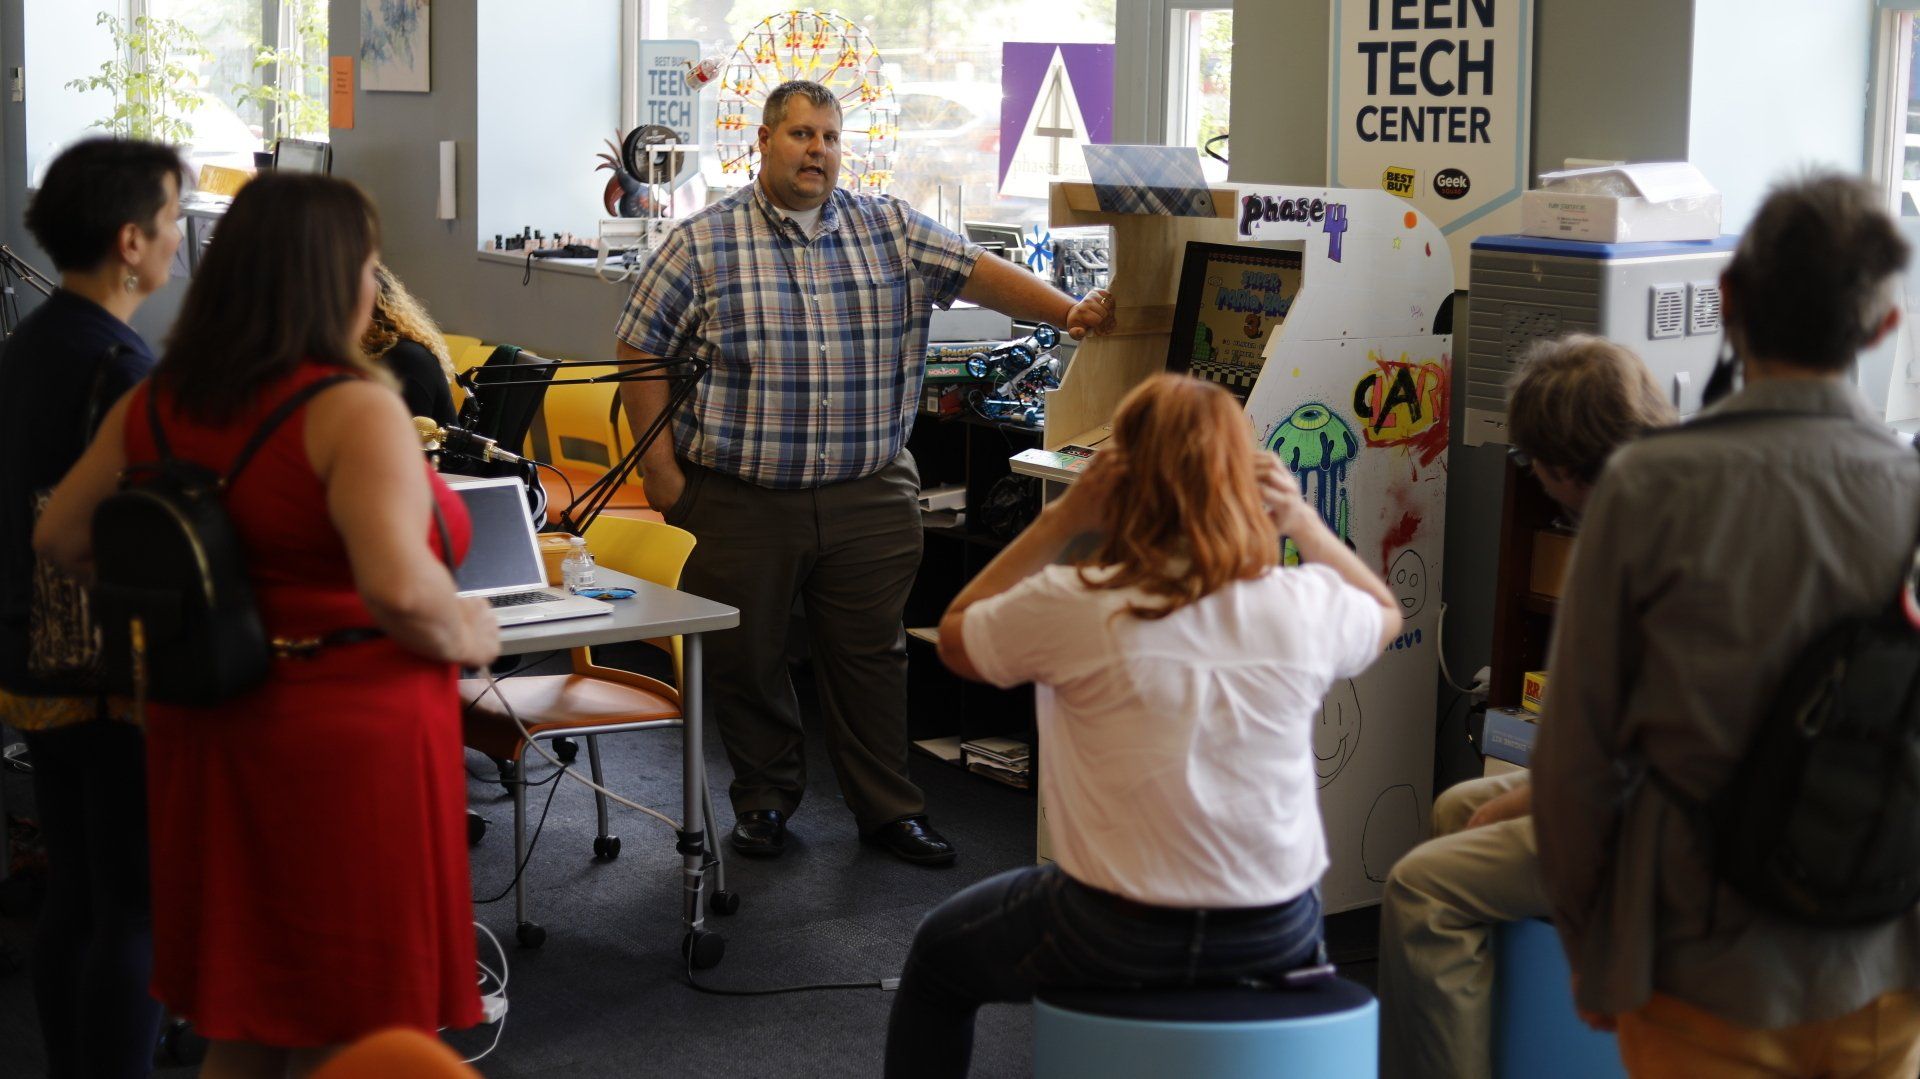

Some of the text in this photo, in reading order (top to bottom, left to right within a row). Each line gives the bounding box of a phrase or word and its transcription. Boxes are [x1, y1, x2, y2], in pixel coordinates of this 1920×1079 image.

[655, 56, 671, 67] BEST
[1357, 39, 1495, 97] TECH
[648, 70, 691, 95] TEEN
[648, 100, 691, 126] TECH
[1356, 105, 1491, 143] CENTER
[1387, 172, 1414, 184] BEST
[1387, 181, 1411, 193] BUY
[1437, 175, 1467, 188] Geek
[1240, 195, 1325, 235] phase
[1243, 314, 1264, 339] 3
[928, 367, 959, 376] MONOPOLY
